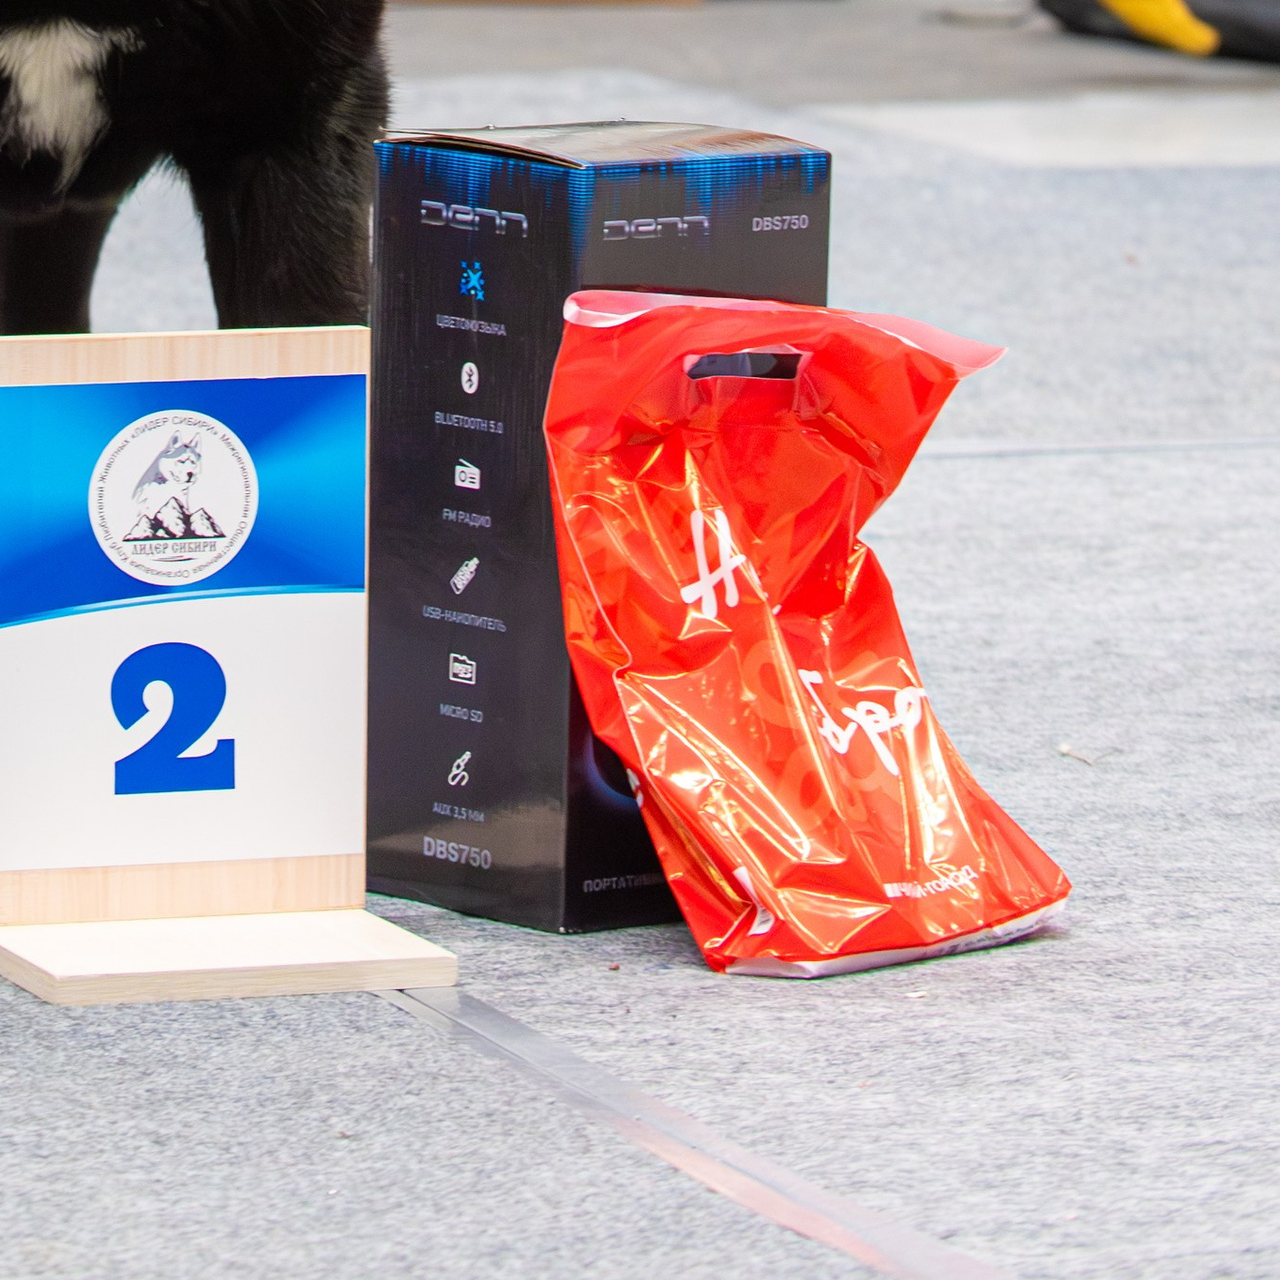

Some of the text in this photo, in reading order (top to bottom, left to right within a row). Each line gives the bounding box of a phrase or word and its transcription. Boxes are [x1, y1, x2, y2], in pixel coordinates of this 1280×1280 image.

[752, 214, 810, 233] DBS750
[436, 314, 507, 337] ЦВЕТОМУЗЫКА
[434, 411, 504, 434] BLUETOOTH 5.0
[442, 508, 492, 528] FM РАДИО
[422, 605, 507, 633] USB-НАКОПИТЕЛЬ
[111, 642, 235, 795] 2
[439, 703, 484, 723] MICRO SD
[432, 802, 452, 816] AUX
[423, 836, 492, 870] DBS750
